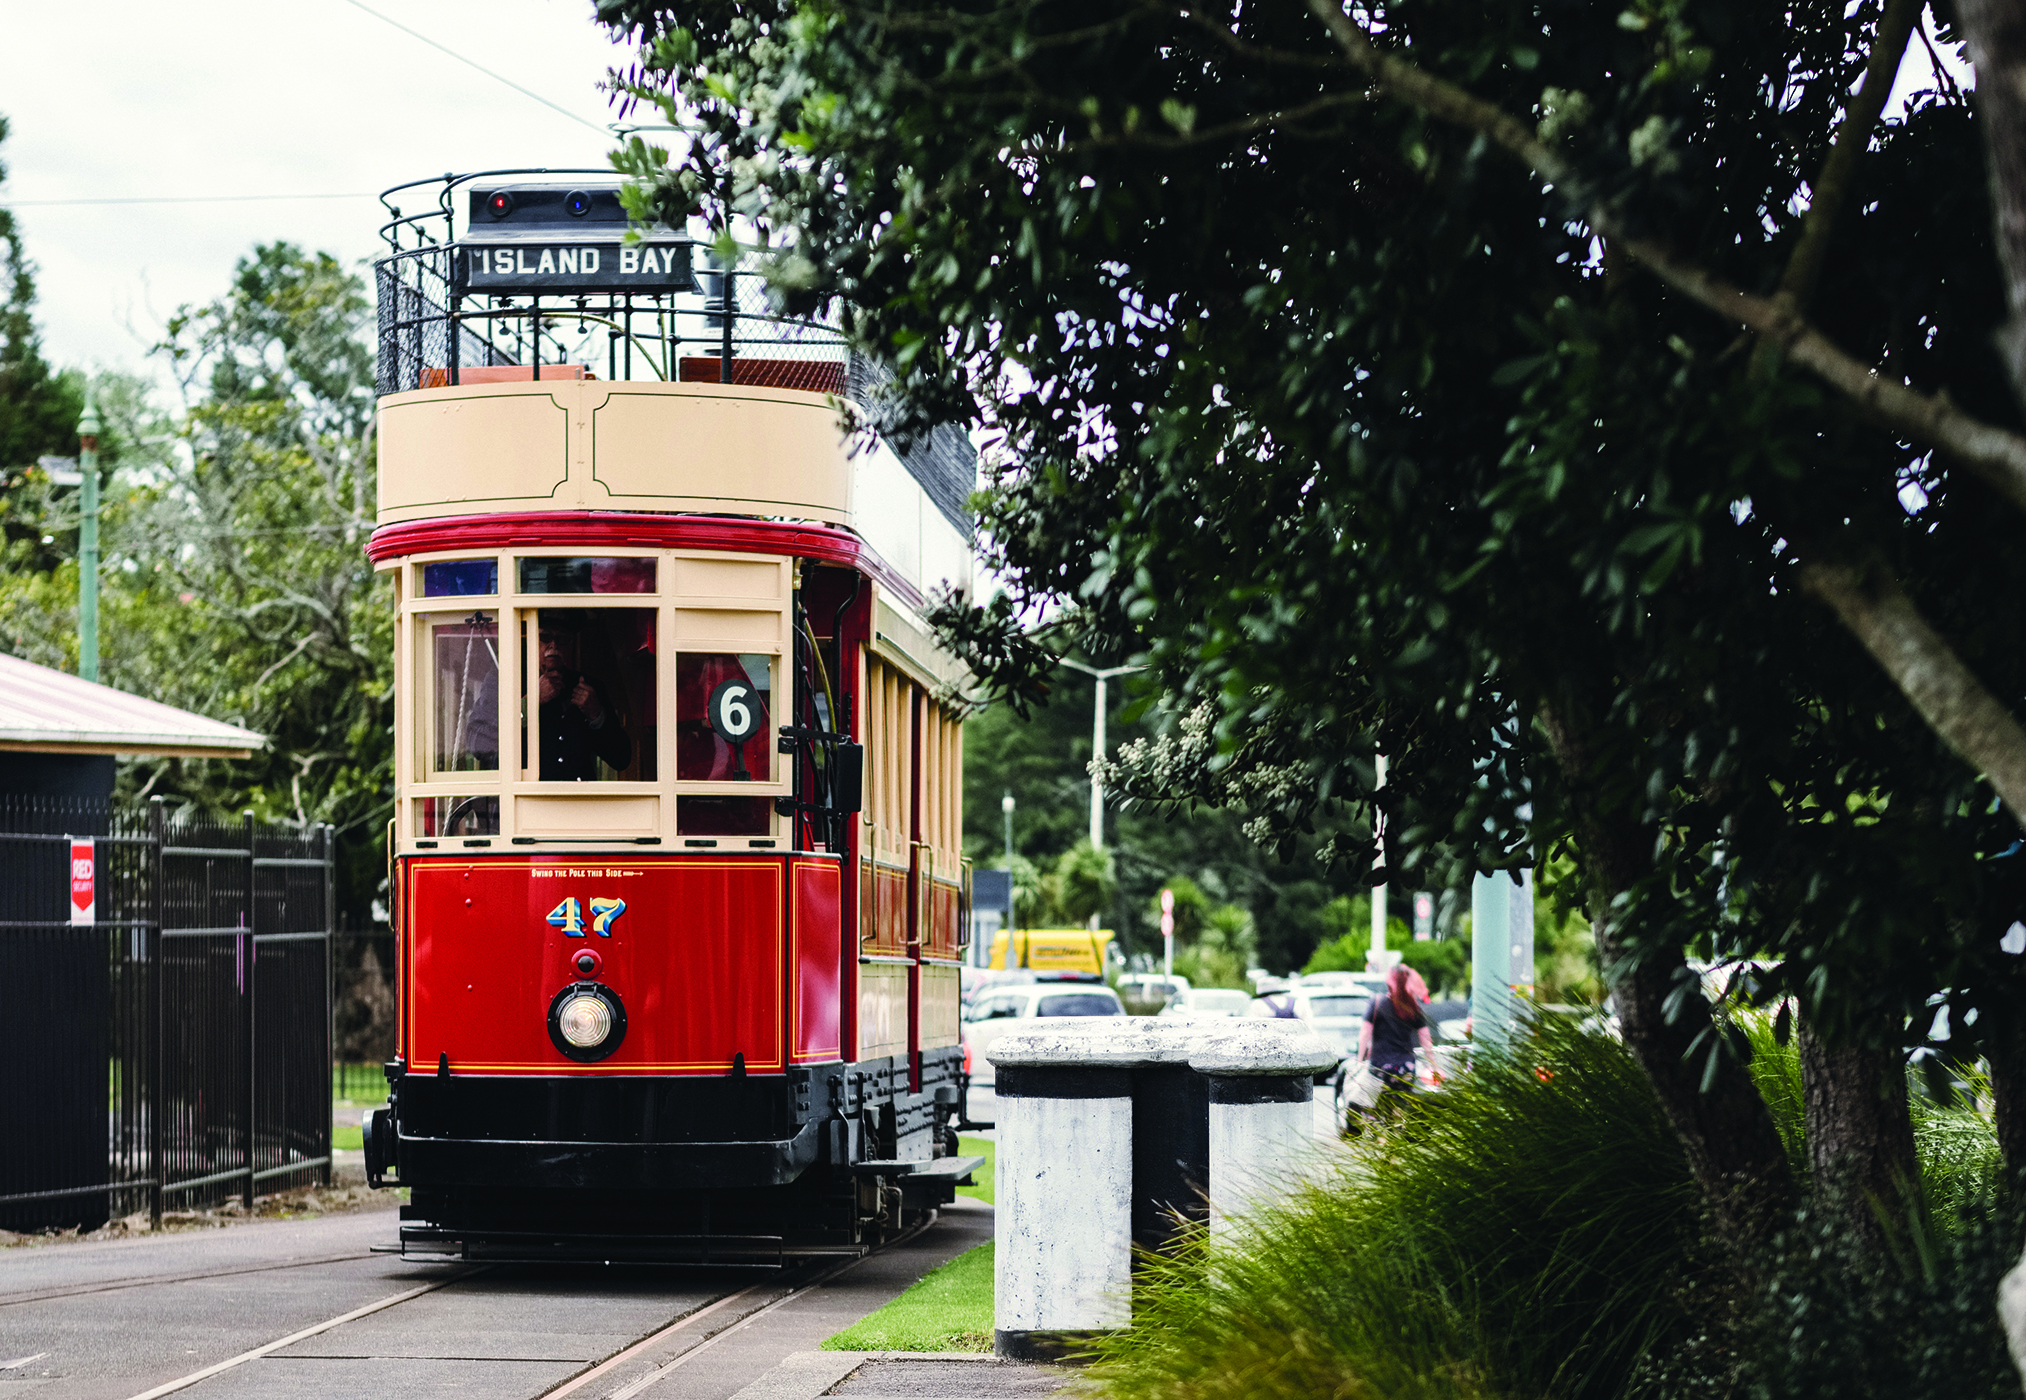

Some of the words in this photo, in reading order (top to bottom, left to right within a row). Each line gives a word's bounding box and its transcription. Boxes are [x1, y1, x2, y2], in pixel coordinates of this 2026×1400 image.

[482, 248, 601, 275] ISLAND
[619, 247, 677, 274] BAY
[720, 685, 751, 736] 6
[73, 859, 92, 880] RED
[545, 897, 627, 938] 47
